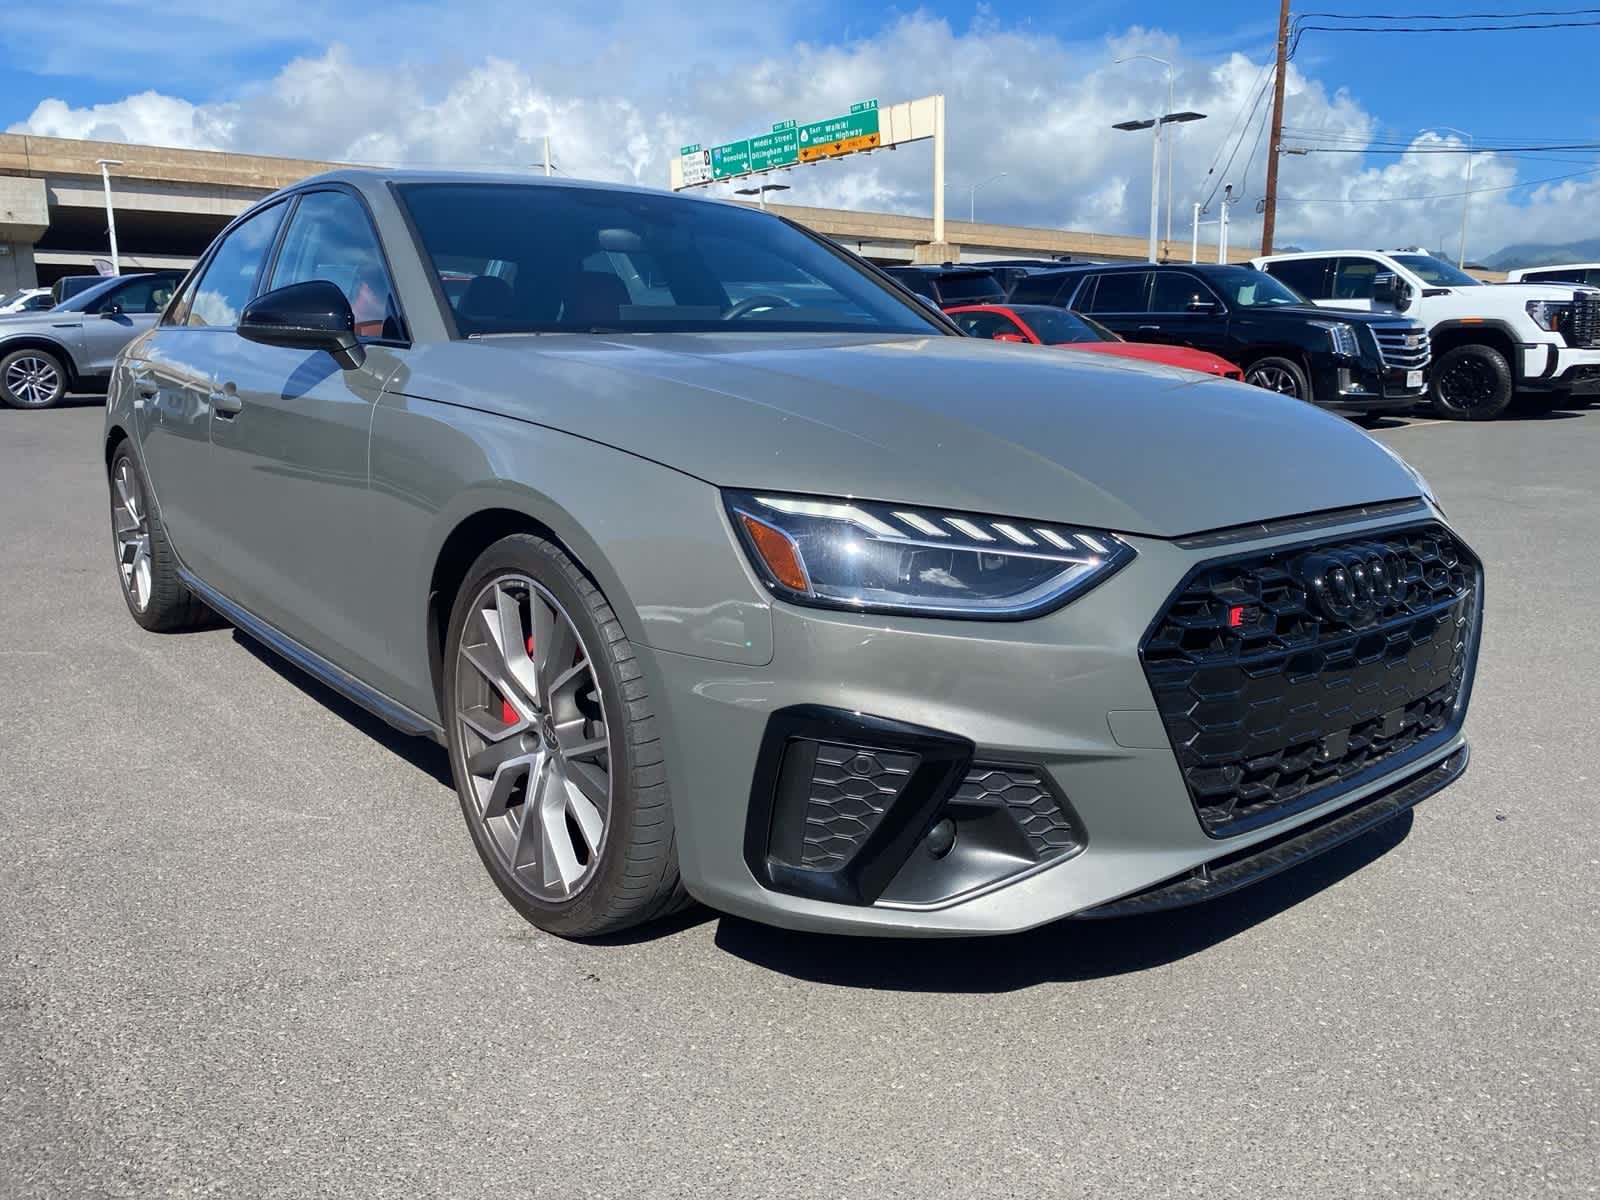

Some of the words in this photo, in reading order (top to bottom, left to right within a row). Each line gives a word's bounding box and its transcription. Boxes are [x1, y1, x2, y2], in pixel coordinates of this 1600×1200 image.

[809, 127, 821, 135] EAST
[825, 120, 849, 133] Waikiki
[753, 139, 772, 148] Middle
[774, 132, 793, 144] Street
[812, 134, 833, 144] Nimitz
[835, 128, 863, 140] Highway
[723, 151, 748, 162] Honolulu
[751, 147, 782, 159] Dillingham
[783, 143, 797, 152] Blvd
